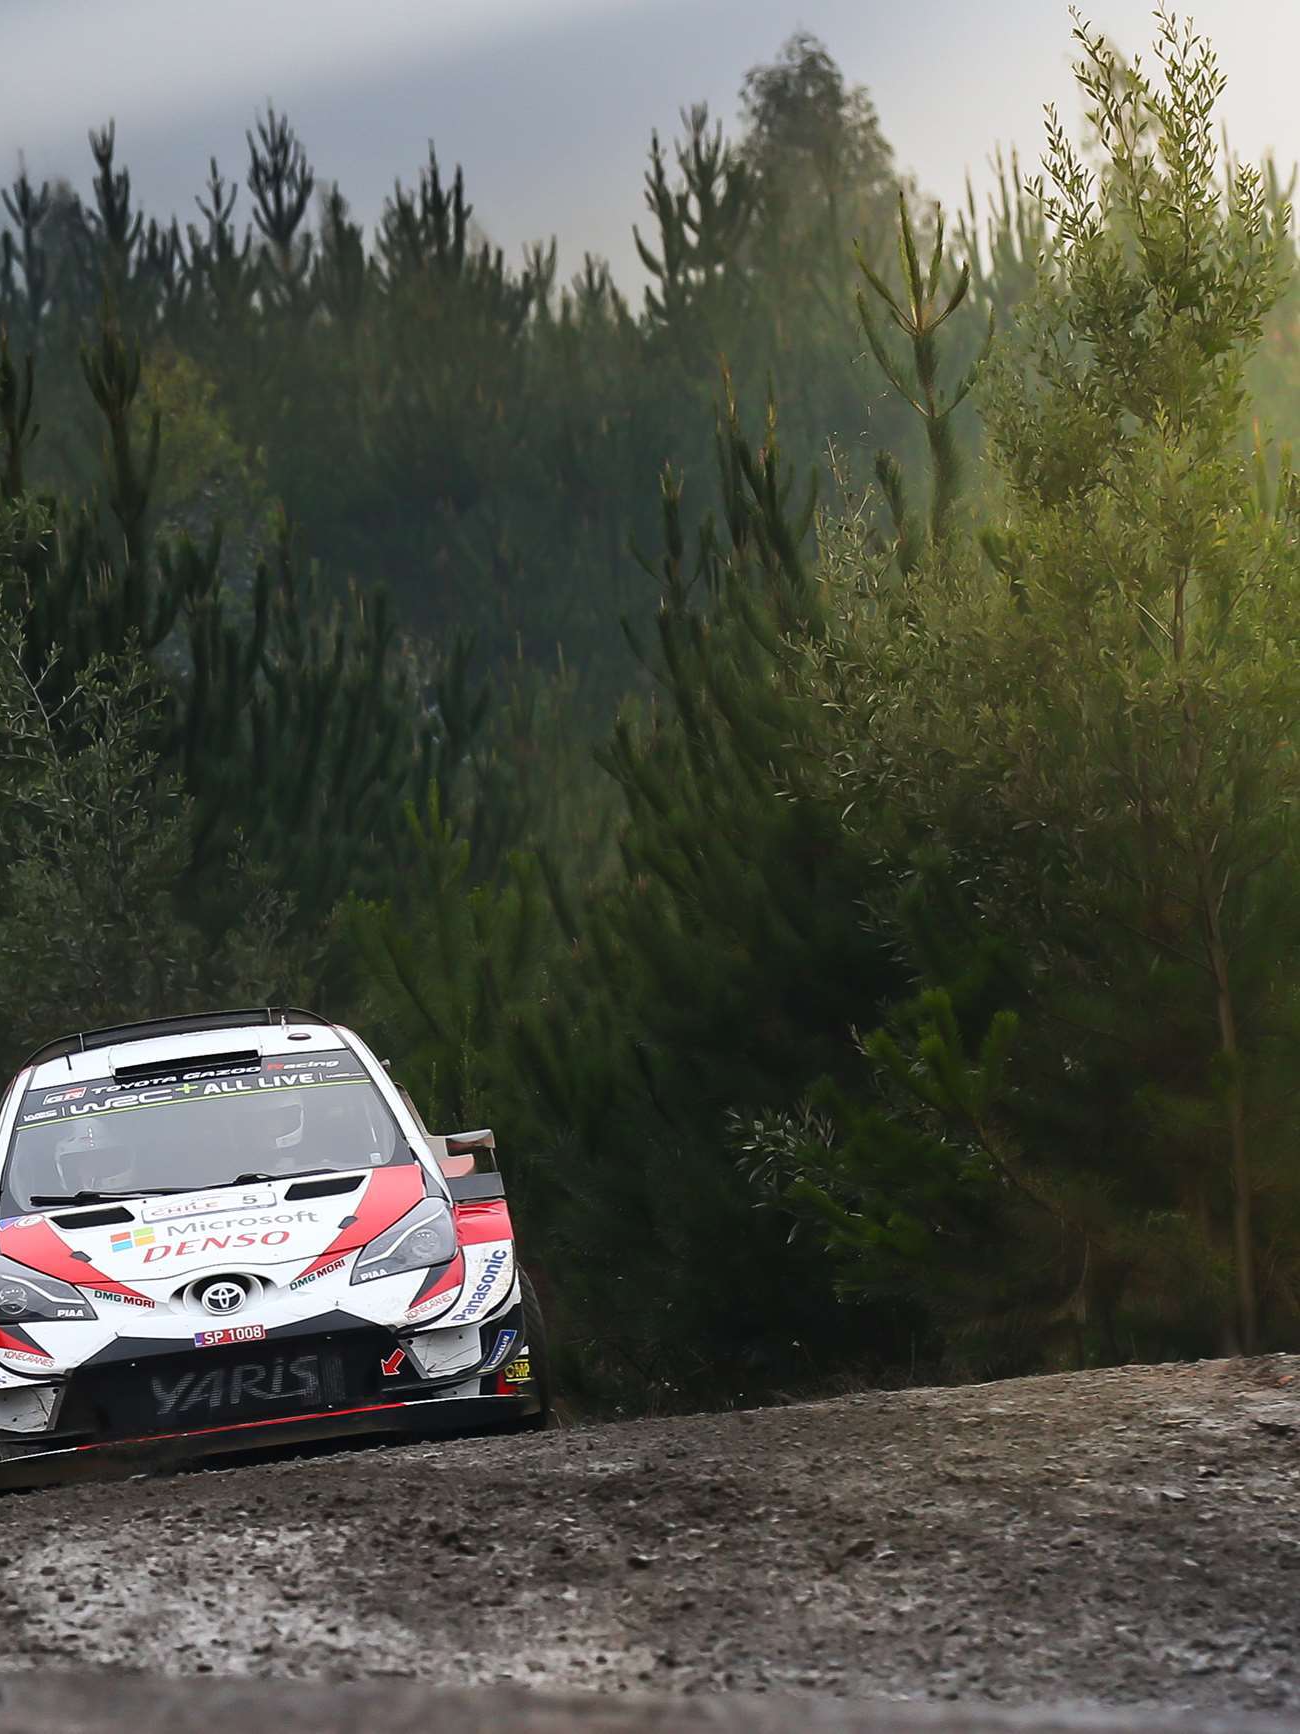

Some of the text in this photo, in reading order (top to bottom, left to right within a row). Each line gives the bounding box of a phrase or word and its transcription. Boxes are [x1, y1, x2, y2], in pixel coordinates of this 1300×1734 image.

[91, 1076, 177, 1095] TOYOTA
[182, 1065, 262, 1081] GAZOO
[267, 1059, 339, 1071] Racing
[203, 1079, 252, 1095] ALL
[258, 1073, 314, 1089] LIVE
[242, 1195, 258, 1205] 5
[166, 1211, 320, 1237] Microsoft
[143, 1231, 290, 1264] DENSO
[289, 1259, 346, 1292] DMG MORI
[360, 1269, 389, 1281] PIAA
[451, 1249, 508, 1323] Panasonic
[94, 1290, 156, 1310] DMG MORI
[57, 1308, 85, 1318] PIAA
[203, 1325, 262, 1344] SP 1008
